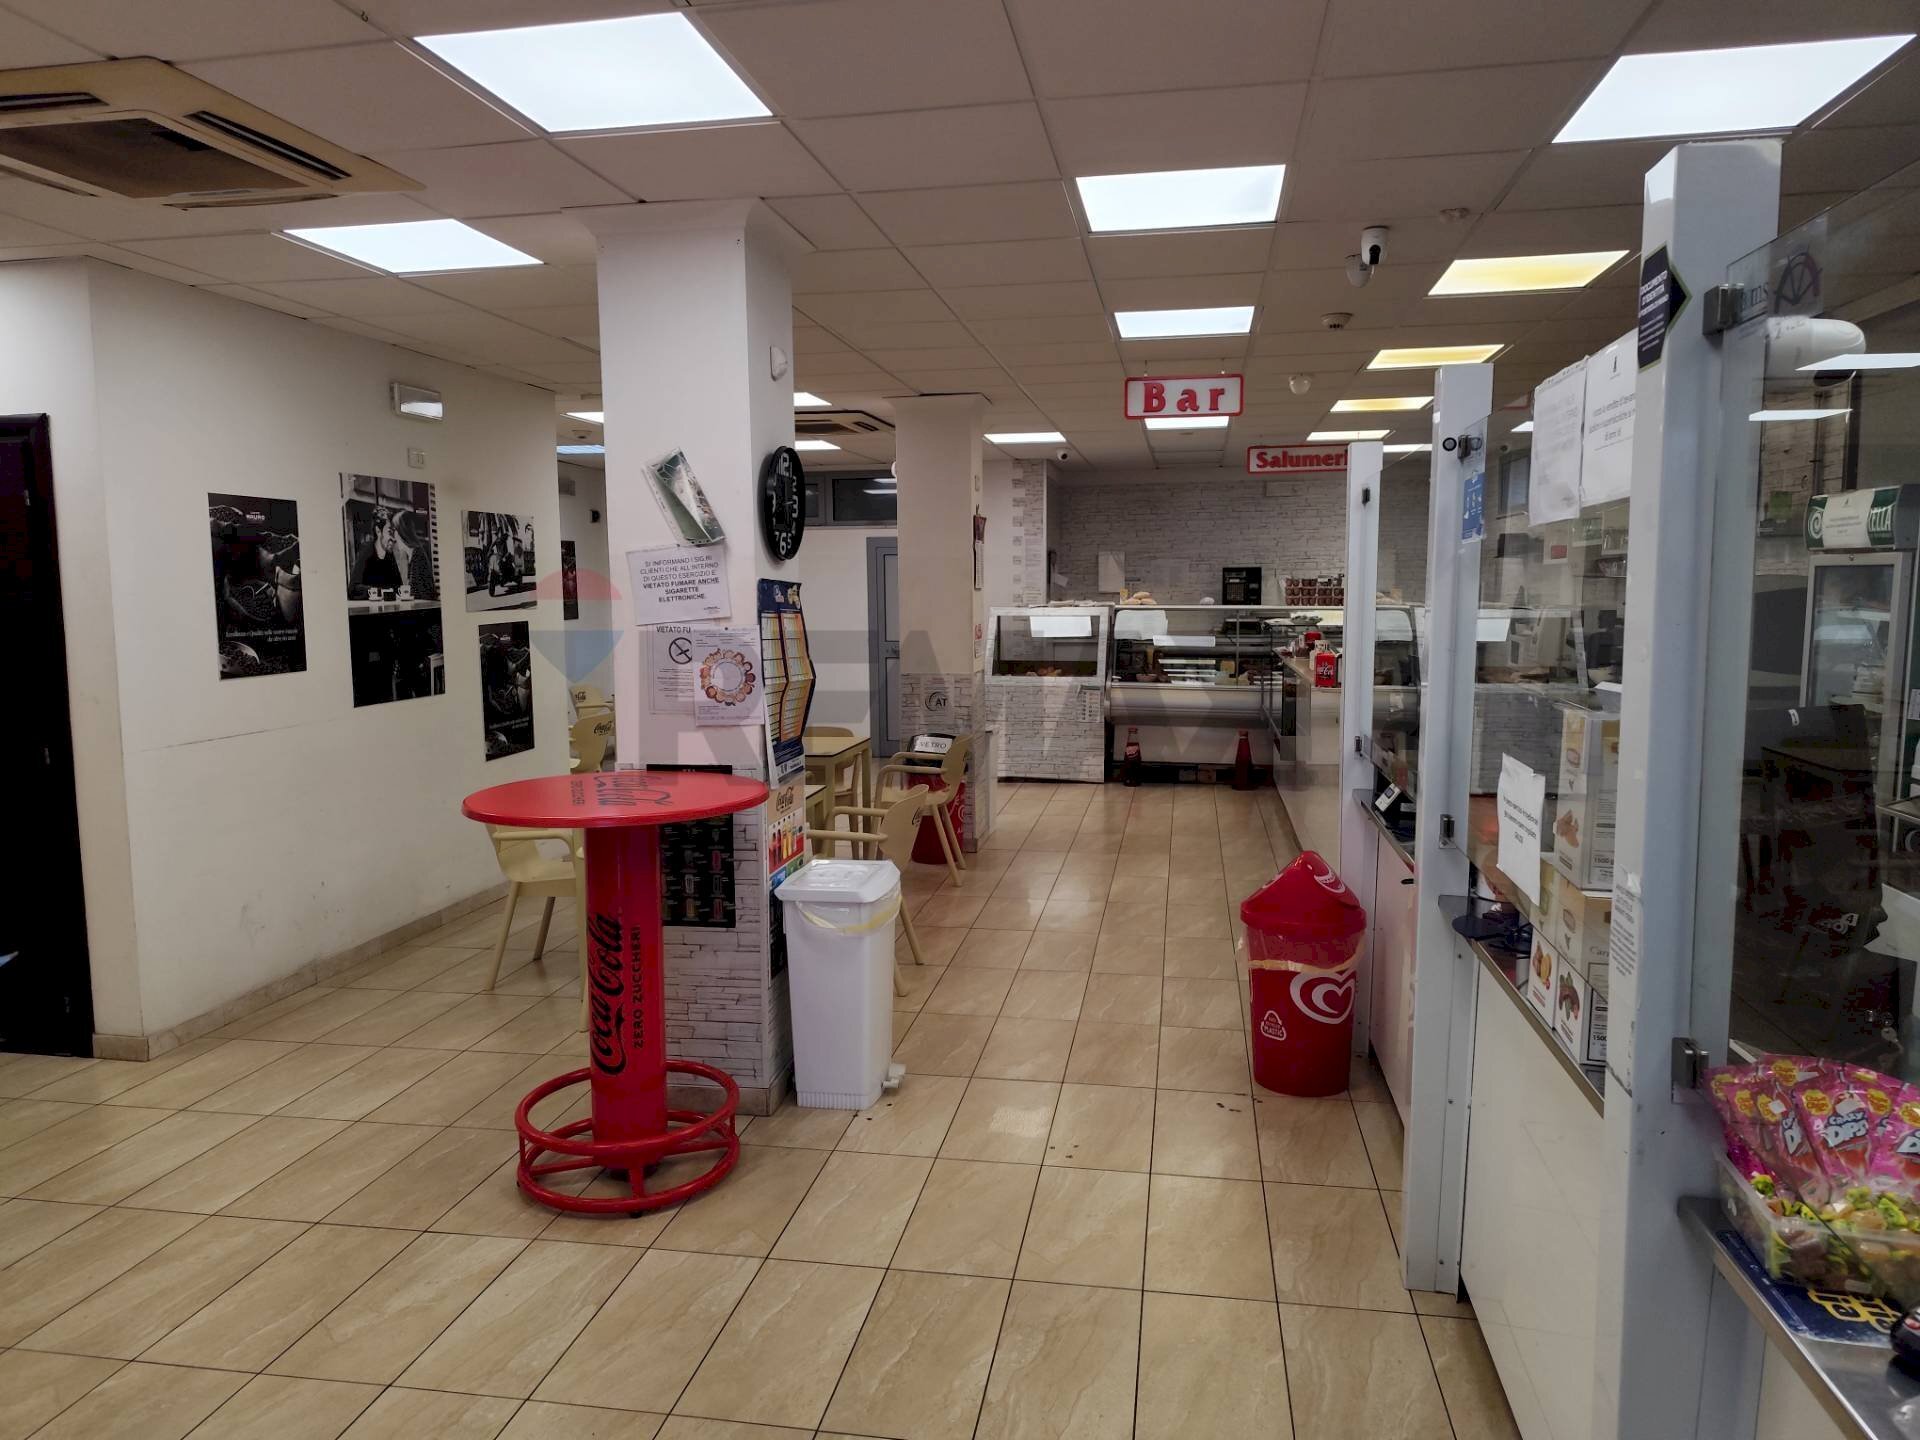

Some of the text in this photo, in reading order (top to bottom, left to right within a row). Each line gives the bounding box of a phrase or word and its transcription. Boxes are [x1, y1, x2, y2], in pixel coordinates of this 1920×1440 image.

[1143, 383, 1225, 413] Bar
[792, 495, 799, 518] 3
[780, 532, 787, 555] 6
[640, 567, 665, 576] CLIENTI
[665, 565, 678, 573] CHE
[650, 572, 678, 582] QUESTO
[679, 570, 711, 580] ESERCIZIO
[643, 577, 720, 589] VIETATO FUMARE ANCHE
[665, 586, 699, 595] SIGARETTE
[656, 625, 682, 634] VIETATO
[920, 741, 947, 750] VETRO
[630, 925, 644, 1049] ZERO ZUCCHERI
[587, 911, 627, 1077] Coca-Cola
